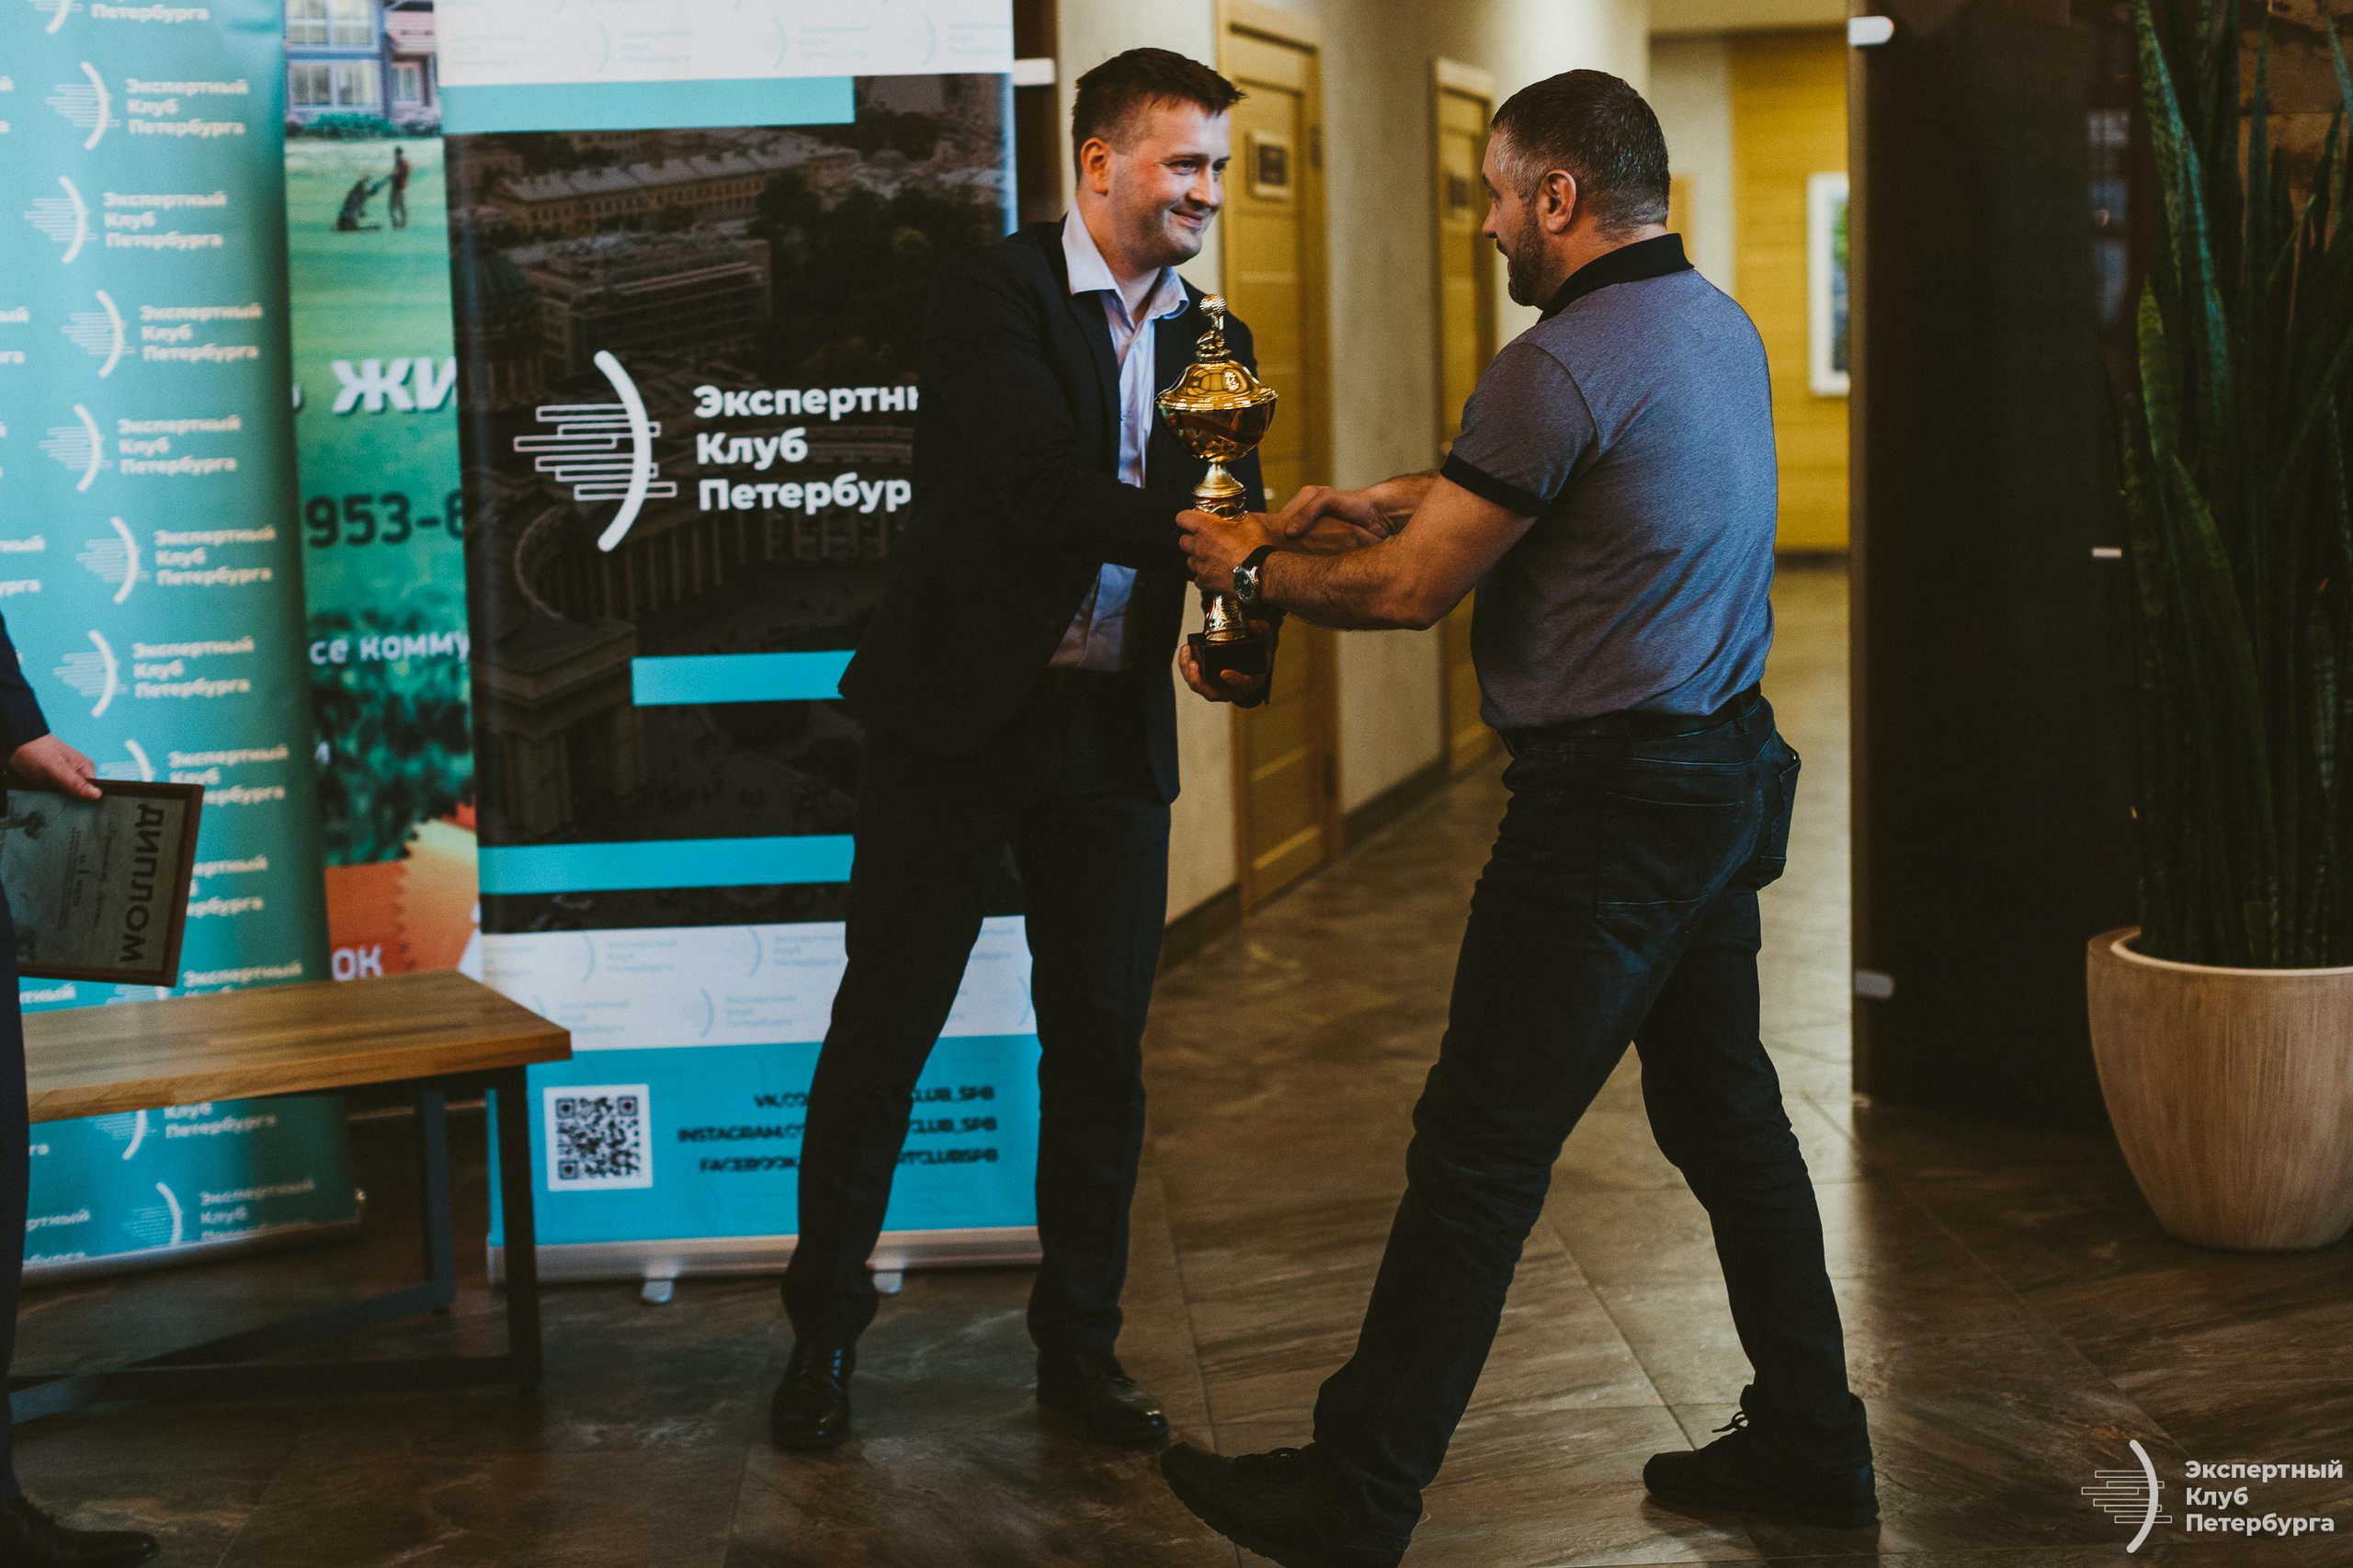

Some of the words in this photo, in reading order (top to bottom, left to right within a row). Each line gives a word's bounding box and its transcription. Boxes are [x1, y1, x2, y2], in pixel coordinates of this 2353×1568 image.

[92, 3, 209, 22] Петербурга
[126, 79, 248, 96] Экспертный
[127, 99, 178, 116] Клуб
[129, 119, 245, 138] Петербурга
[104, 190, 227, 210] Экспертный
[105, 211, 156, 230] Клуб
[107, 231, 223, 250] Петербурга
[141, 304, 262, 321] Экспертный
[142, 324, 192, 342] Клуб
[142, 344, 259, 362] Петербурга
[693, 384, 918, 421] Экспертн
[118, 415, 241, 434] Экспертный
[119, 437, 170, 456] Клуб
[696, 427, 808, 471] Клуб
[120, 456, 236, 476] Петербурга
[699, 472, 912, 516] Петербур
[153, 526, 276, 547] Экспертный
[156, 548, 206, 566] Клуб
[157, 566, 272, 586] Петербурга
[132, 636, 255, 658] Экспертный
[134, 659, 184, 679] Клуб
[135, 677, 250, 698] Петербурга
[119, 803, 165, 962] ДИПЛОМ
[754, 1091, 810, 1108] VK.CO
[677, 1123, 806, 1142] INSTAGRAM.CO
